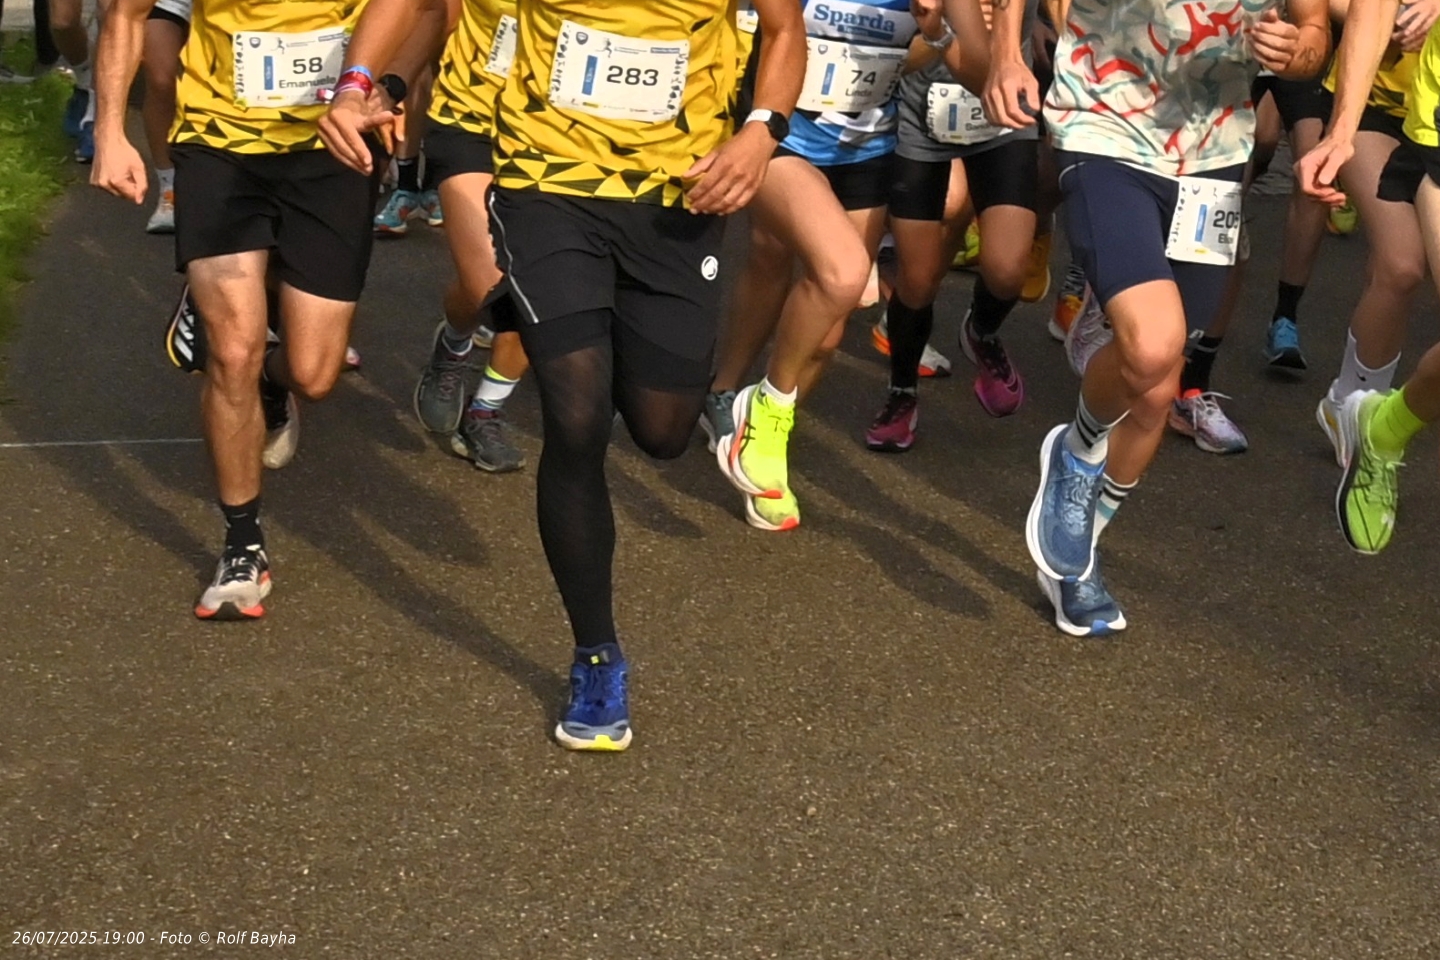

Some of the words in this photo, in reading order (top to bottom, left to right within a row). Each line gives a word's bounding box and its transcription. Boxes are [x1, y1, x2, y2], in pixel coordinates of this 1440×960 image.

[813, 3, 895, 32] Sparda
[292, 56, 323, 75] 58
[278, 75, 337, 89] Emanuele
[606, 65, 659, 86] 283
[850, 70, 876, 85] 74
[970, 107, 982, 120] 2
